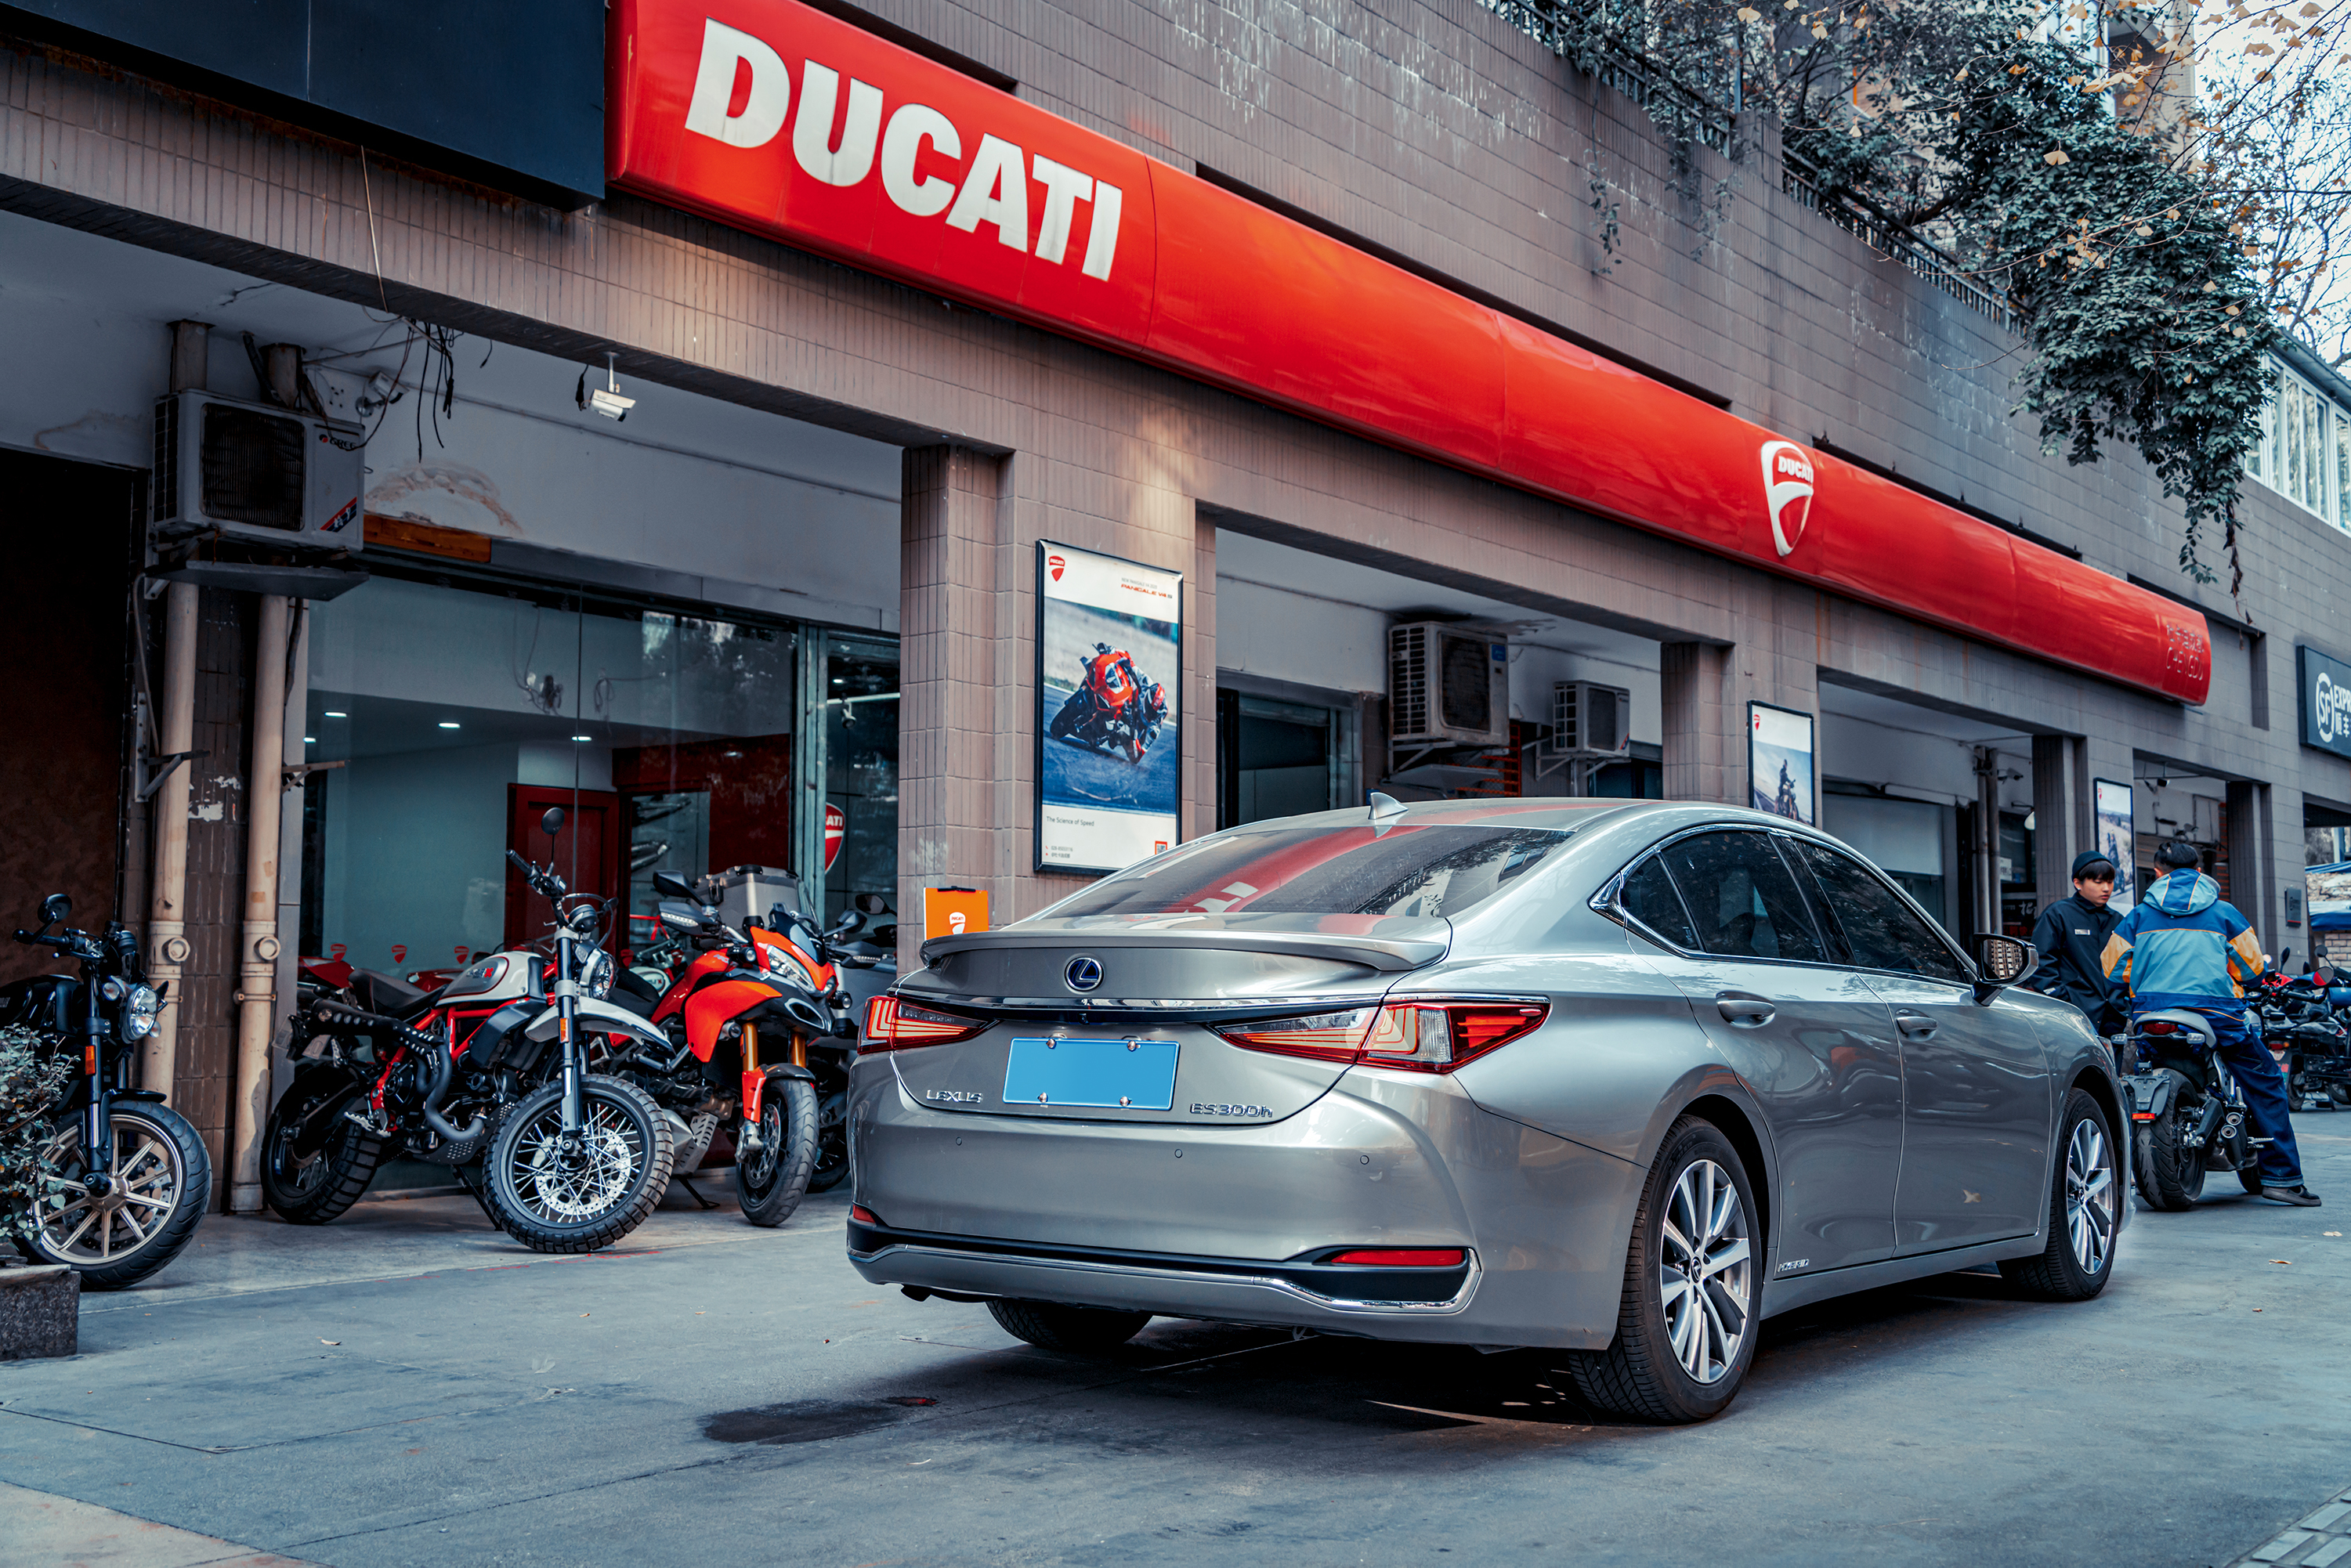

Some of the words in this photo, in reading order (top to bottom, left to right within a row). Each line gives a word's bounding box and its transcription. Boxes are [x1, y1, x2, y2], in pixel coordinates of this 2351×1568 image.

[685, 16, 1123, 281] DUCATI
[330, 436, 357, 450] GREE
[1778, 456, 1814, 484] DUCATI
[1121, 583, 1157, 596] PANIGALE
[2166, 646, 2204, 681] CHENGDU
[2320, 690, 2331, 725] SF
[826, 815, 843, 827] ATI
[926, 1089, 983, 1104] LEXUS
[1190, 1103, 1273, 1118] ES300h
[1778, 1258, 1810, 1273] HYBRID
